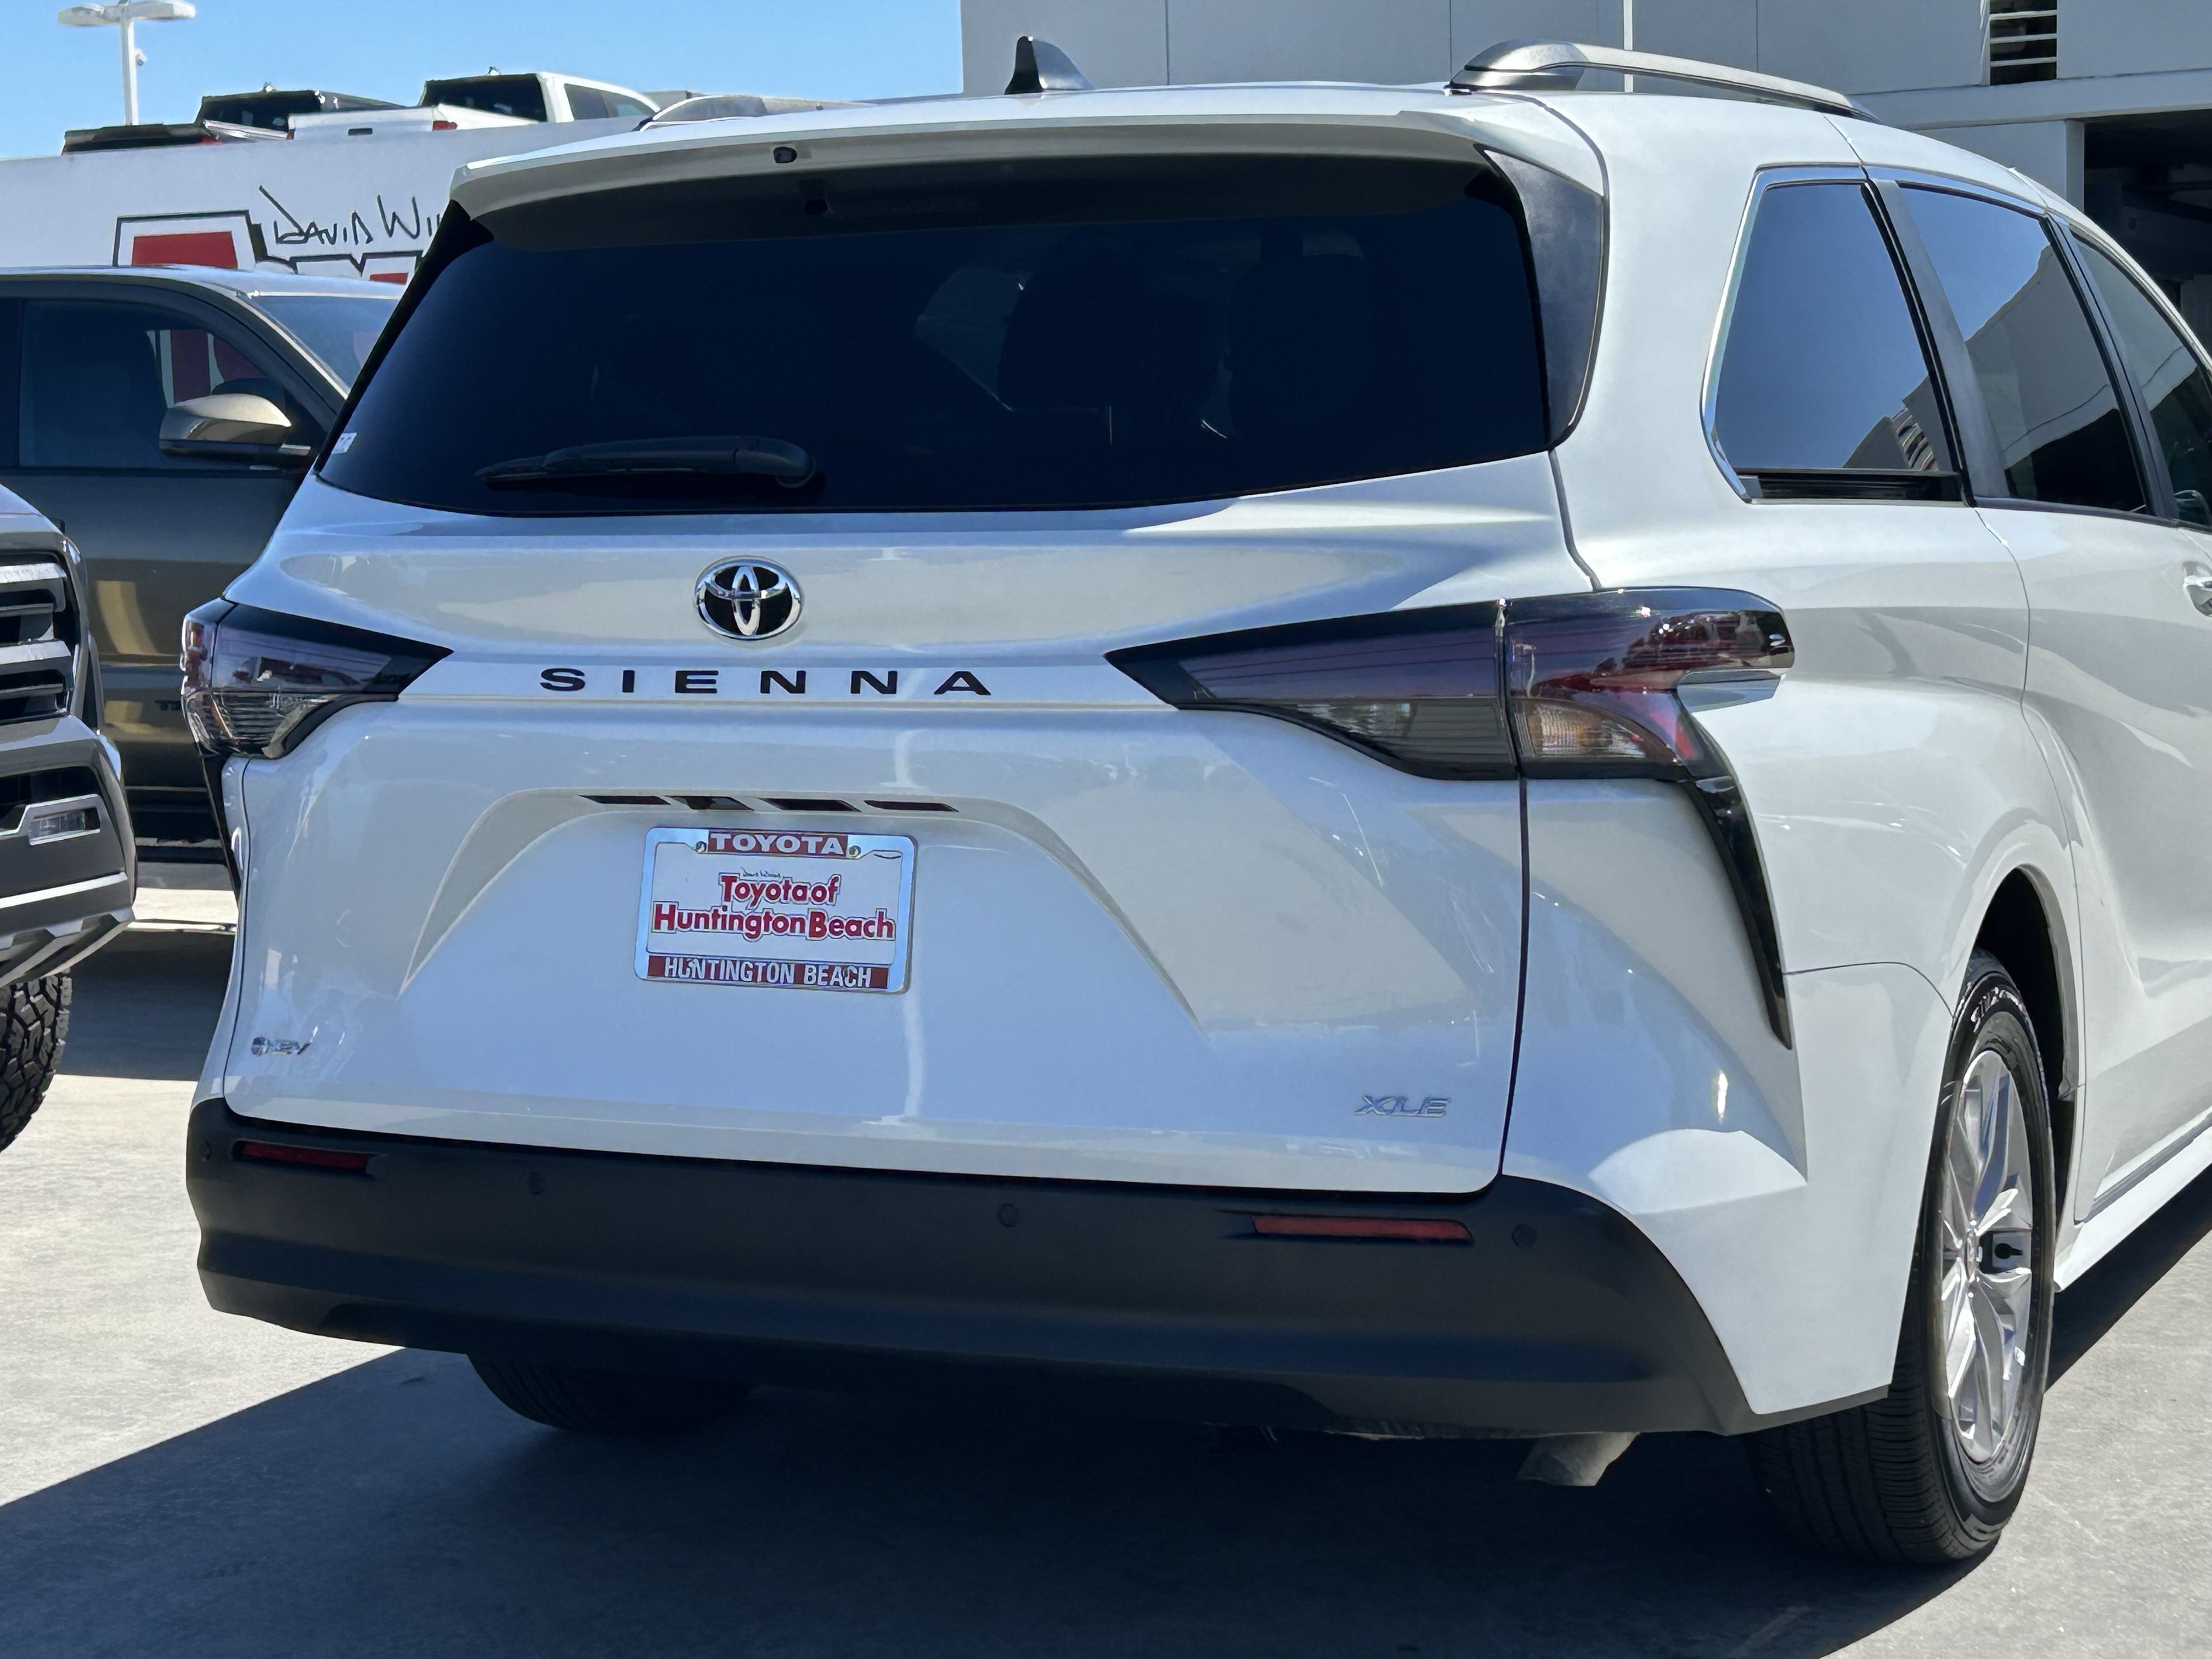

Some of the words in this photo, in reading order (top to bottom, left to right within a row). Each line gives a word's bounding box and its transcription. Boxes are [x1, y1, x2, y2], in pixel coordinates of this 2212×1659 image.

[540, 668, 991, 696] SIENNA
[711, 833, 844, 855] TOYOTA
[721, 875, 808, 907] Toyota
[811, 876, 839, 902] of
[654, 903, 806, 939] Huntington
[809, 911, 894, 938] Beach
[664, 957, 795, 984] HUNTINGTON
[804, 964, 872, 988] BEACH
[1353, 1095, 1452, 1118] XLE
